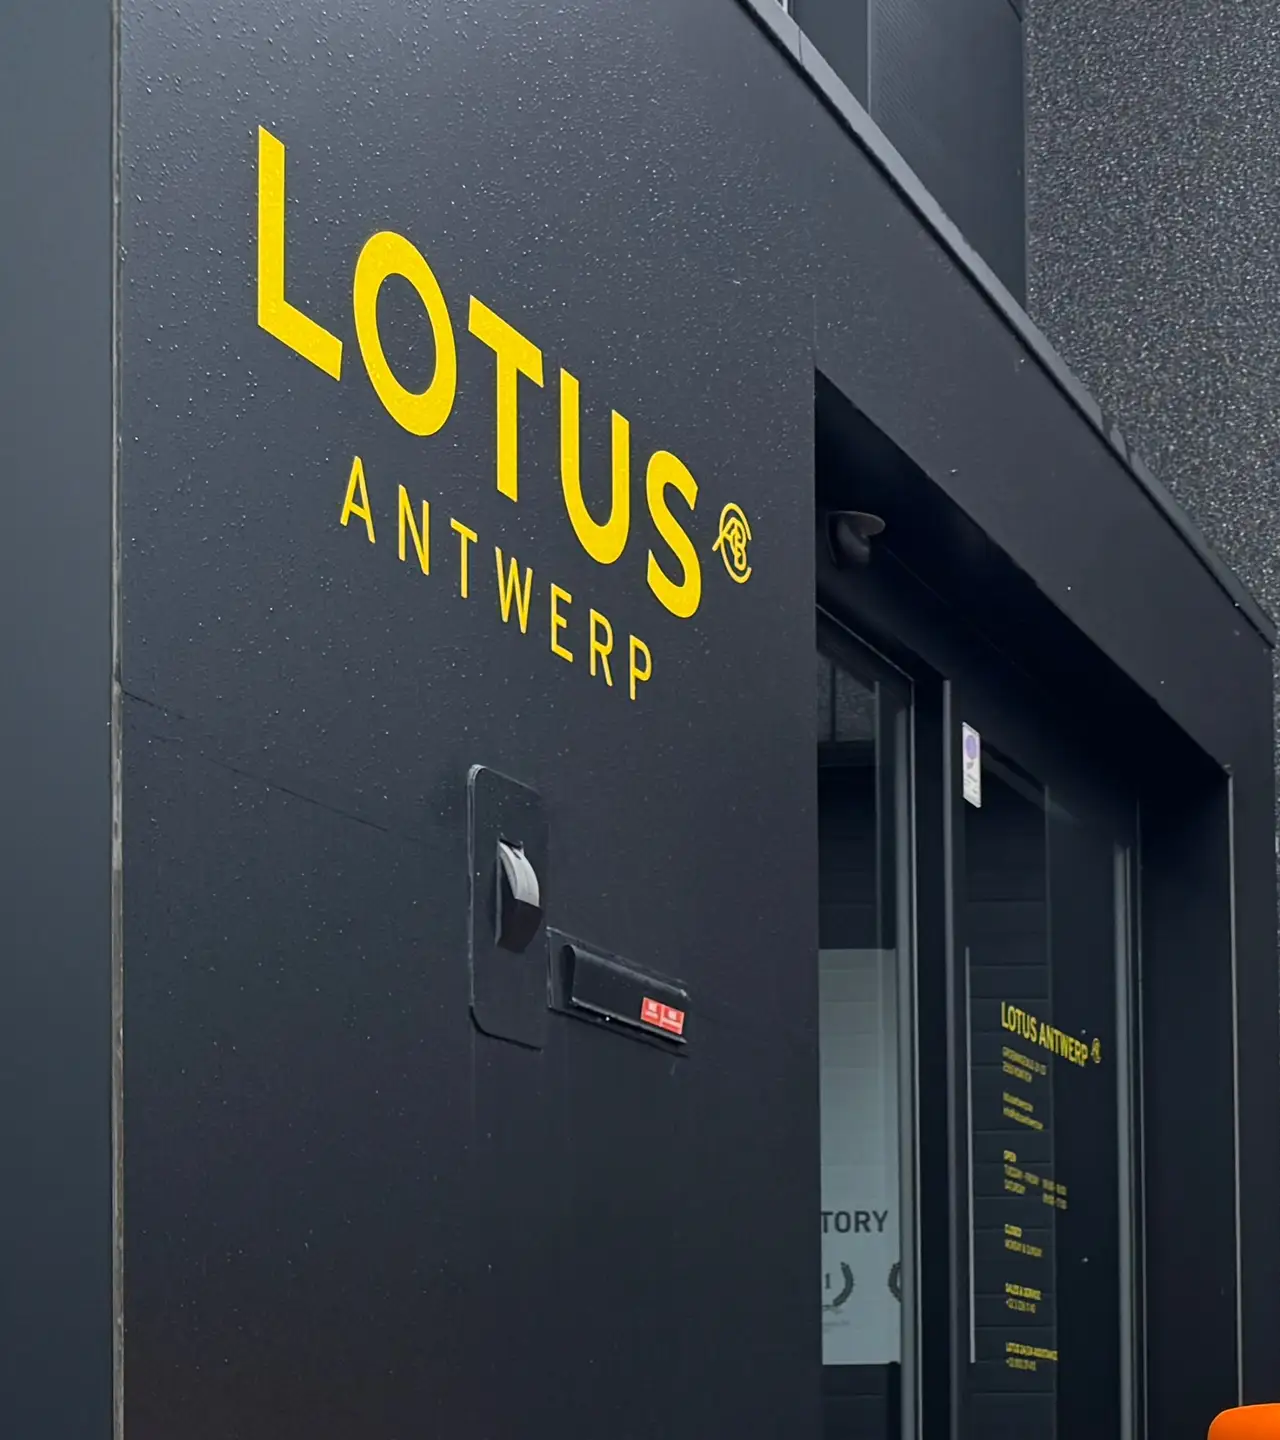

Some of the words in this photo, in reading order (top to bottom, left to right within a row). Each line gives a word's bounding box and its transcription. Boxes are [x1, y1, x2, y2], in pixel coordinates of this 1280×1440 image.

[258, 125, 703, 619] LOTUS
[340, 456, 653, 701] ANTWERP
[1001, 1001, 1037, 1043] LOTUS
[1039, 1022, 1088, 1067] ANTWERP
